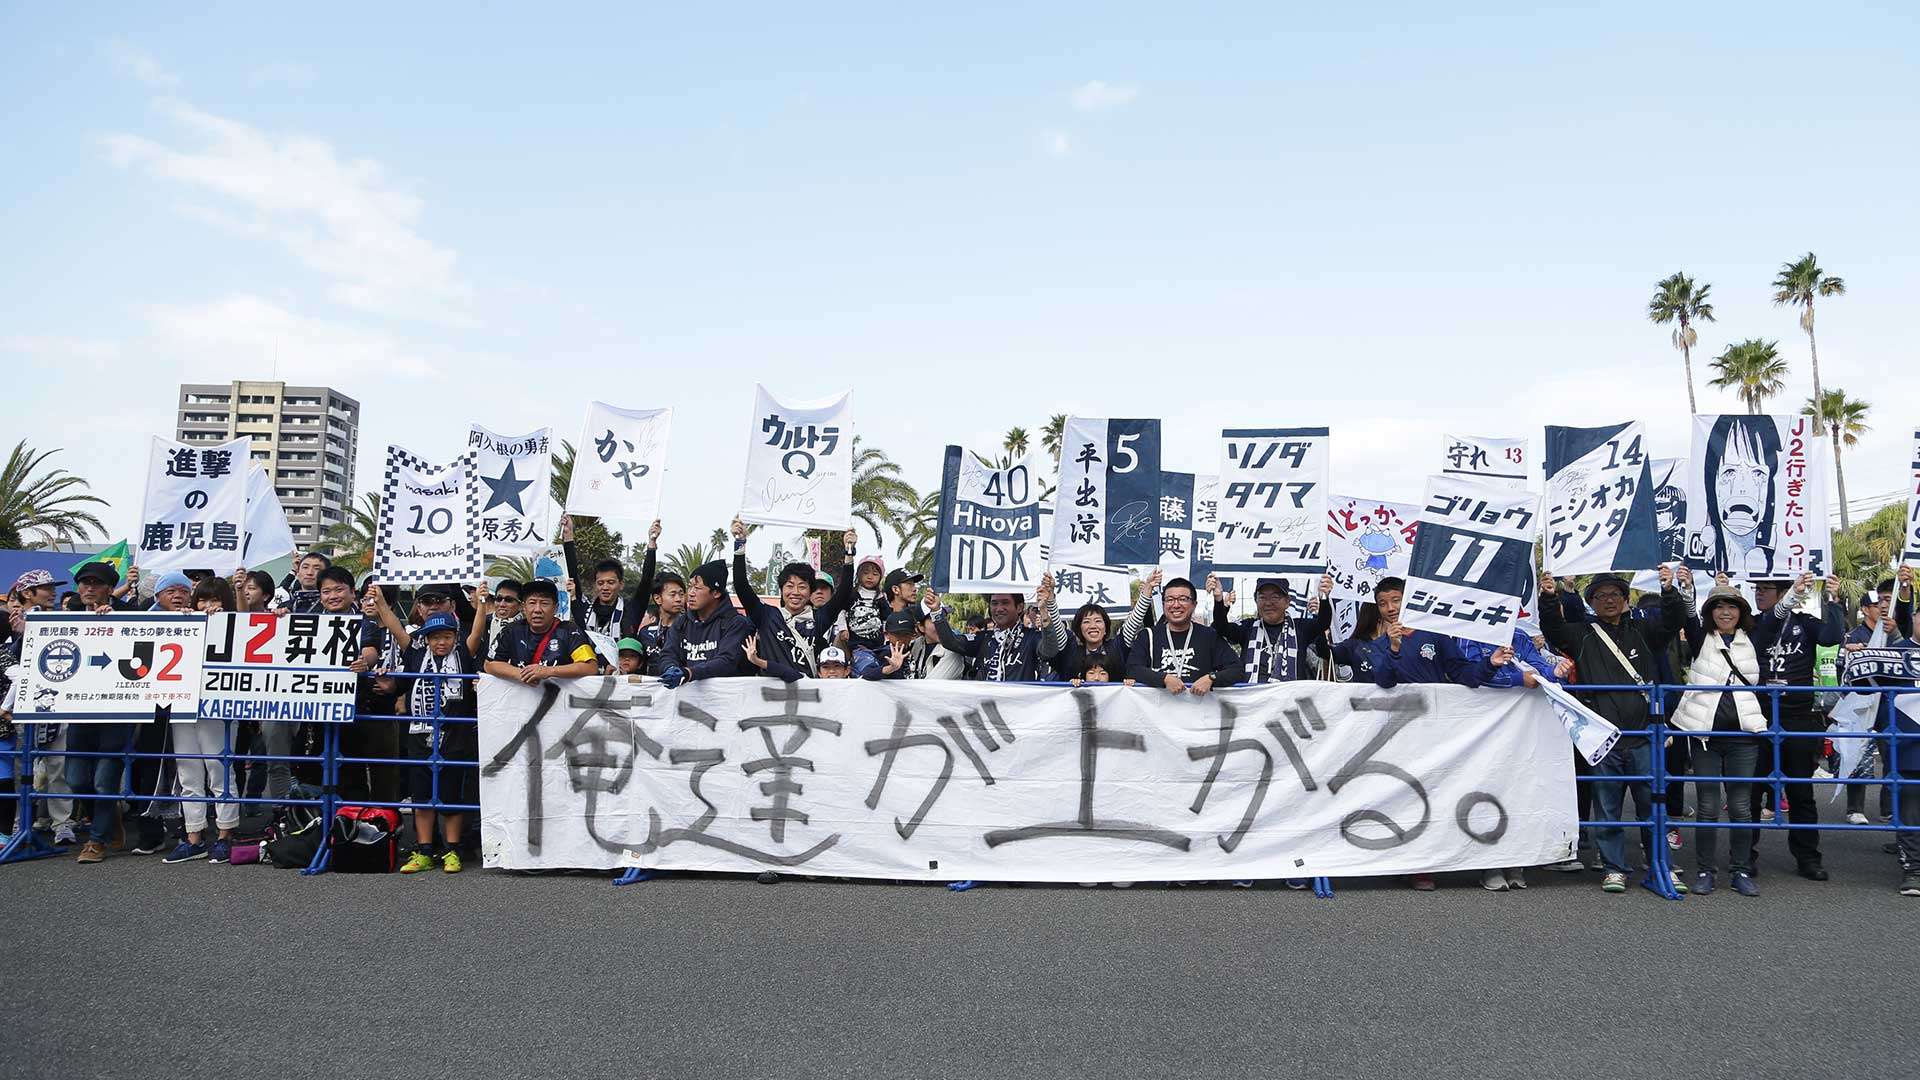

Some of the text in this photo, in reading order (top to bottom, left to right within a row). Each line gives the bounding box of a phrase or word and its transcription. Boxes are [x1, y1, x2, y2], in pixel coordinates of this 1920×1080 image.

[468, 430, 549, 457] 阿久根の勇者
[762, 414, 839, 456] ウルトラ
[165, 448, 232, 479] 進撃
[594, 429, 650, 490] かや
[781, 449, 816, 480] Q
[1112, 433, 1140, 473] 5
[1447, 442, 1523, 471] 守れ 13
[1601, 434, 1643, 471] 14
[184, 490, 209, 510] の
[405, 480, 459, 496] masaki
[983, 464, 1029, 506] 40
[1070, 443, 1102, 545] 平出涼
[1224, 482, 1317, 509] タクマ
[1549, 475, 1635, 527] ニシオカ
[406, 504, 453, 535] 10
[953, 503, 1033, 537] Hiroya
[1425, 494, 1533, 530] ゴリョウ
[140, 522, 240, 552] 鹿児島
[1218, 520, 1273, 540] ゲット
[1549, 508, 1628, 558] ケンタ
[392, 545, 465, 559] sakamoto
[1253, 541, 1321, 560] ゴール
[1434, 533, 1503, 584] 11
[1405, 590, 1513, 626] ジュンキ
[38, 626, 200, 637] 鹿児島発 J2行き 俺たちの夢を乗せて
[206, 613, 363, 667] J2昇格
[205, 672, 355, 694] 2018.11.25 SUN
[481, 676, 1508, 868] 俺達が上がる。
